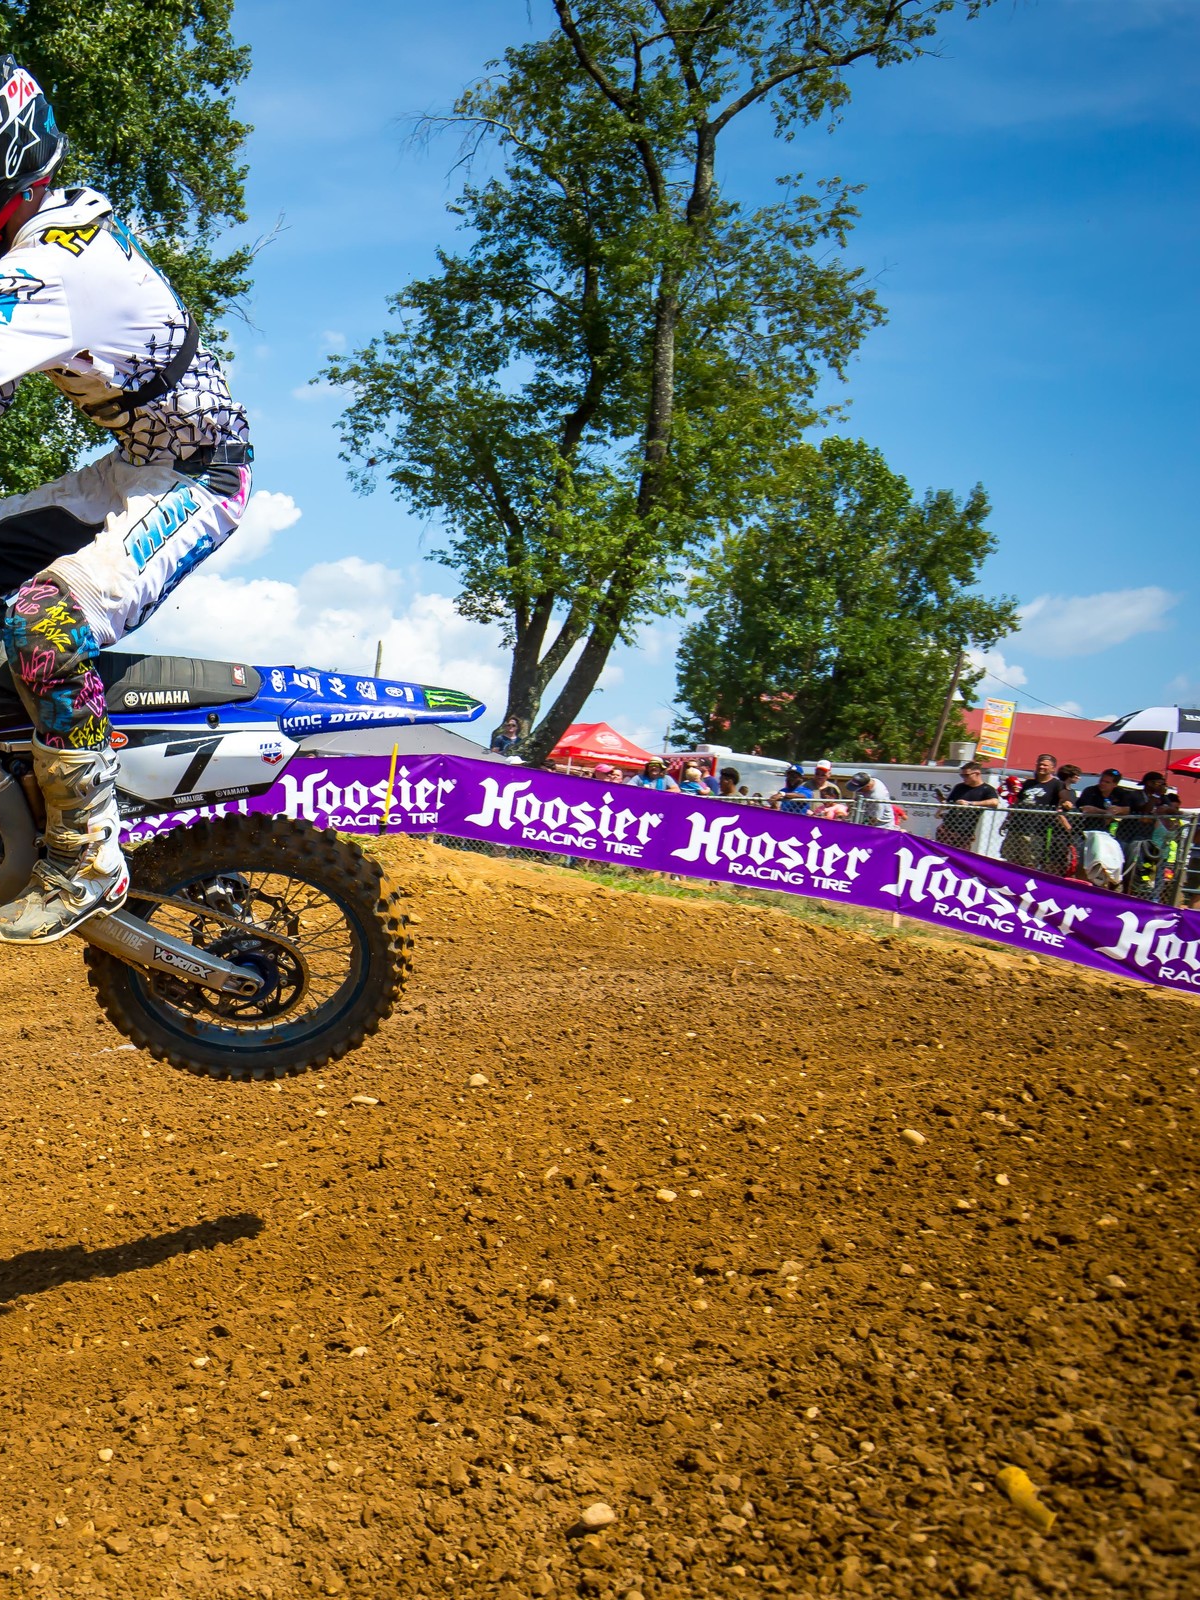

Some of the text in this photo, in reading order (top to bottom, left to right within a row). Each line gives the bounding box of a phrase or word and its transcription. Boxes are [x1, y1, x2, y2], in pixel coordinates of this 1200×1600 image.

[139, 690, 190, 705] YAMAHA
[283, 714, 322, 729] KMC
[164, 736, 224, 796] 7
[173, 793, 205, 805] YAMALUBE
[222, 786, 250, 797] YAMAHA
[272, 765, 456, 823] Hoosier
[901, 782, 952, 793] MIKE'S
[329, 812, 402, 828] RACING
[464, 777, 663, 846] Hoosier
[521, 826, 644, 858] RACING TIRE
[670, 811, 872, 880] Hoosier
[728, 862, 853, 894] RACING TIRE
[880, 847, 1091, 936] Hoosier
[932, 901, 1067, 949] RACING TIRE
[155, 946, 216, 980] VORTEX
